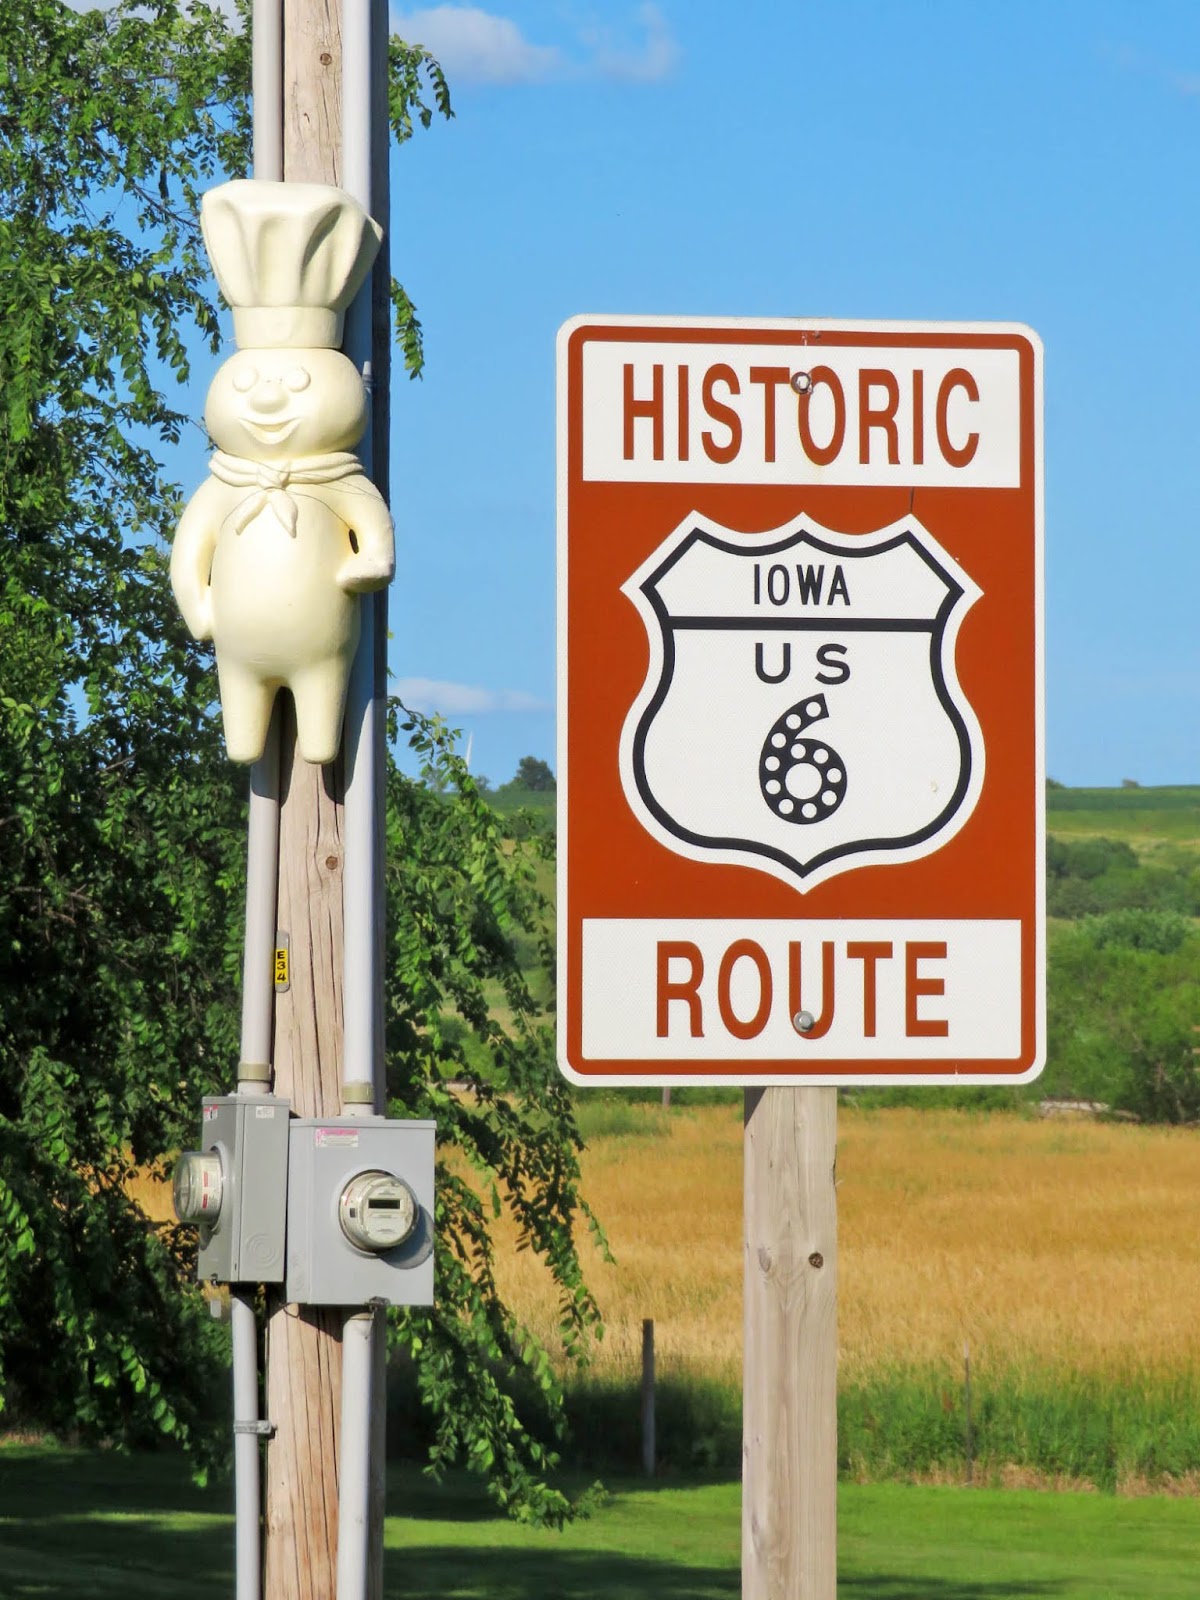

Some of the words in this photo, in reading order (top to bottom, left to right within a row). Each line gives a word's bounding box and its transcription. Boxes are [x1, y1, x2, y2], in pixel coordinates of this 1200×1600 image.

[623, 364, 980, 468] HISTORIC
[753, 564, 851, 606] IOWA
[758, 693, 848, 825] 6
[656, 938, 949, 1040] ROUTE
